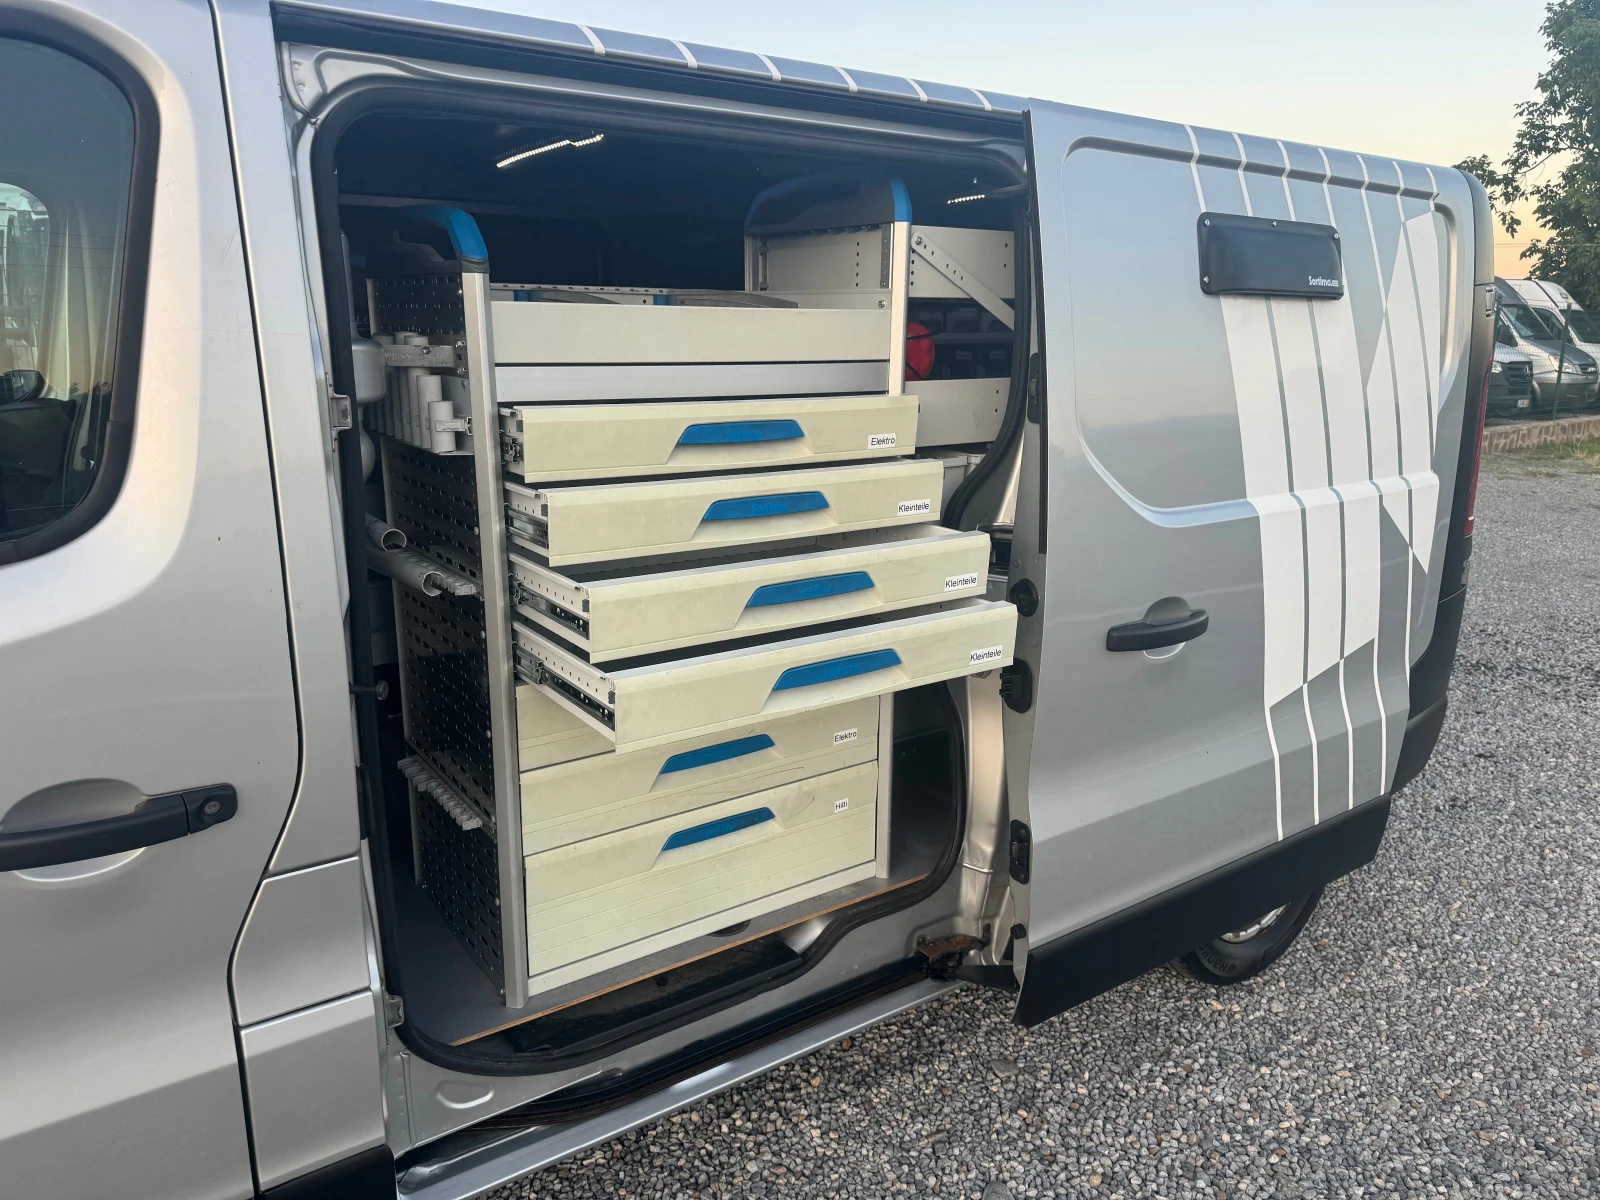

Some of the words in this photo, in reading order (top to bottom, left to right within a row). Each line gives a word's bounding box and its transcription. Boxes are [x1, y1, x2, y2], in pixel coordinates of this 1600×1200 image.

[870, 437, 896, 447] Elektro
[898, 502, 930, 513] Kleinteile
[945, 576, 977, 589] Kleinteile
[970, 648, 1002, 662] Kleinteile
[834, 731, 857, 743] Elektro
[835, 800, 848, 811] Hilti
